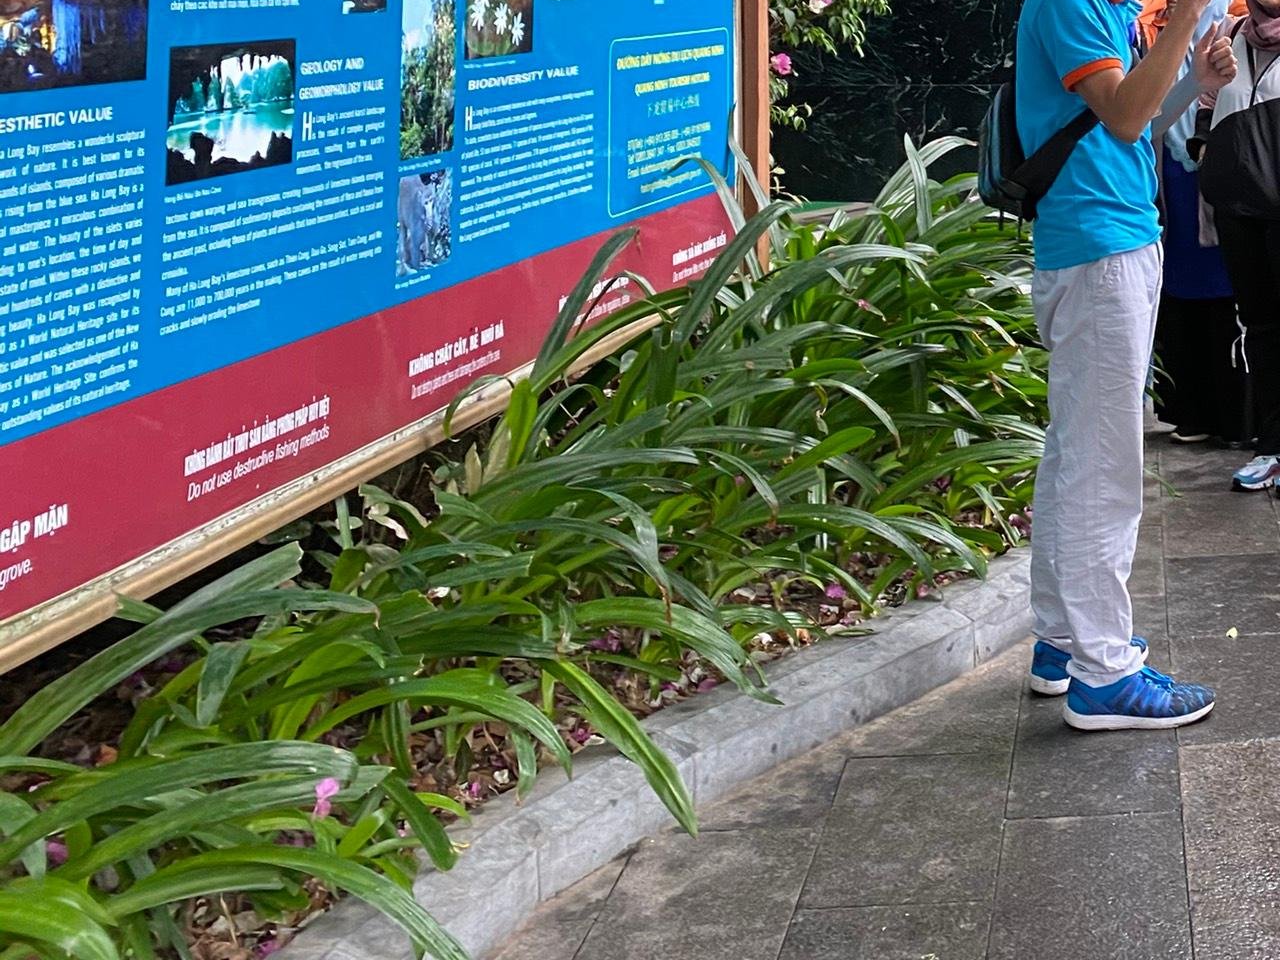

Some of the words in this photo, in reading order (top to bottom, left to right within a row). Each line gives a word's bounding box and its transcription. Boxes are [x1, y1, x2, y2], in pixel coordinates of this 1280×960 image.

[301, 59, 343, 75] GEOLOGY
[345, 57, 364, 70] AND
[468, 70, 543, 91] BIODIVERSITY
[546, 65, 579, 78] VALUE
[69, 106, 113, 125] VALUE
[187, 482, 200, 502] Do
[202, 474, 216, 495] not
[217, 468, 232, 488] use
[275, 440, 299, 460] fishing
[300, 424, 330, 449] methods
[33, 504, 69, 535] MẶN
